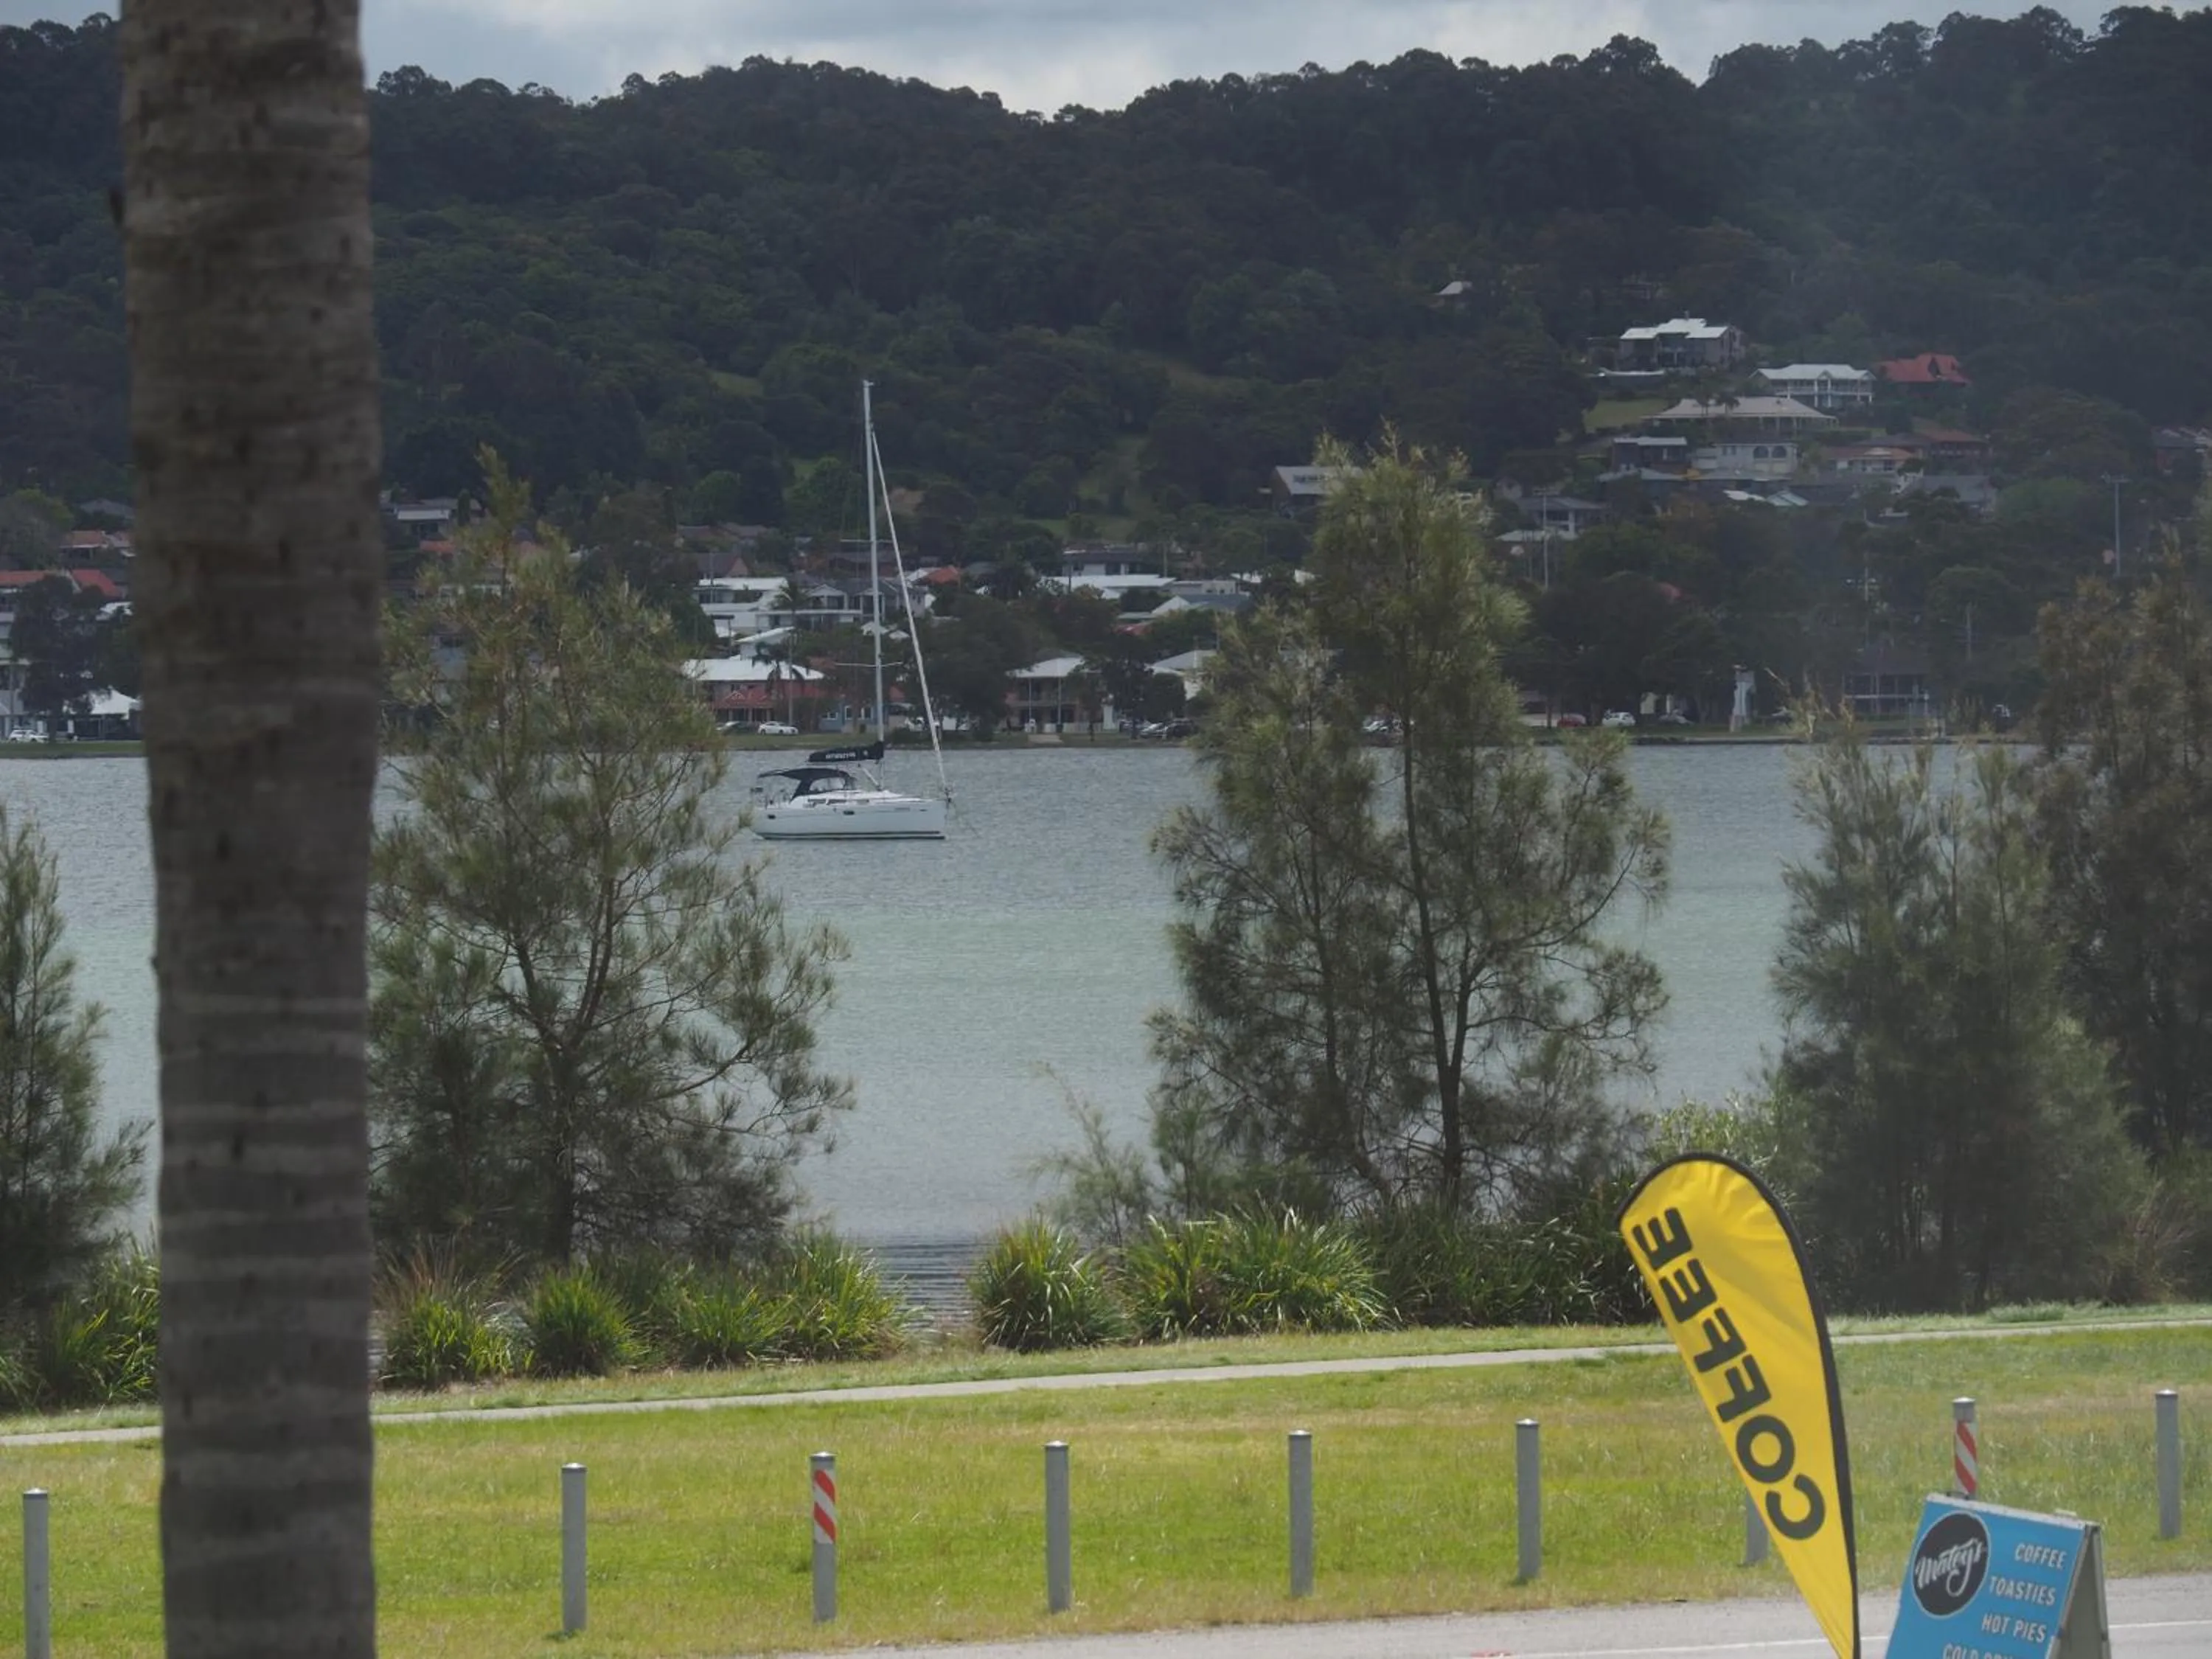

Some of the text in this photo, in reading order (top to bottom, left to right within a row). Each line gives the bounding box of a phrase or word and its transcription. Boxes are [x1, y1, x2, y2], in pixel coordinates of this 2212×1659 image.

[2014, 1543, 2067, 1570] COFFEE
[1989, 1576, 2056, 1606] TOASTIES
[1981, 1613, 2047, 1643] HOT PIES
